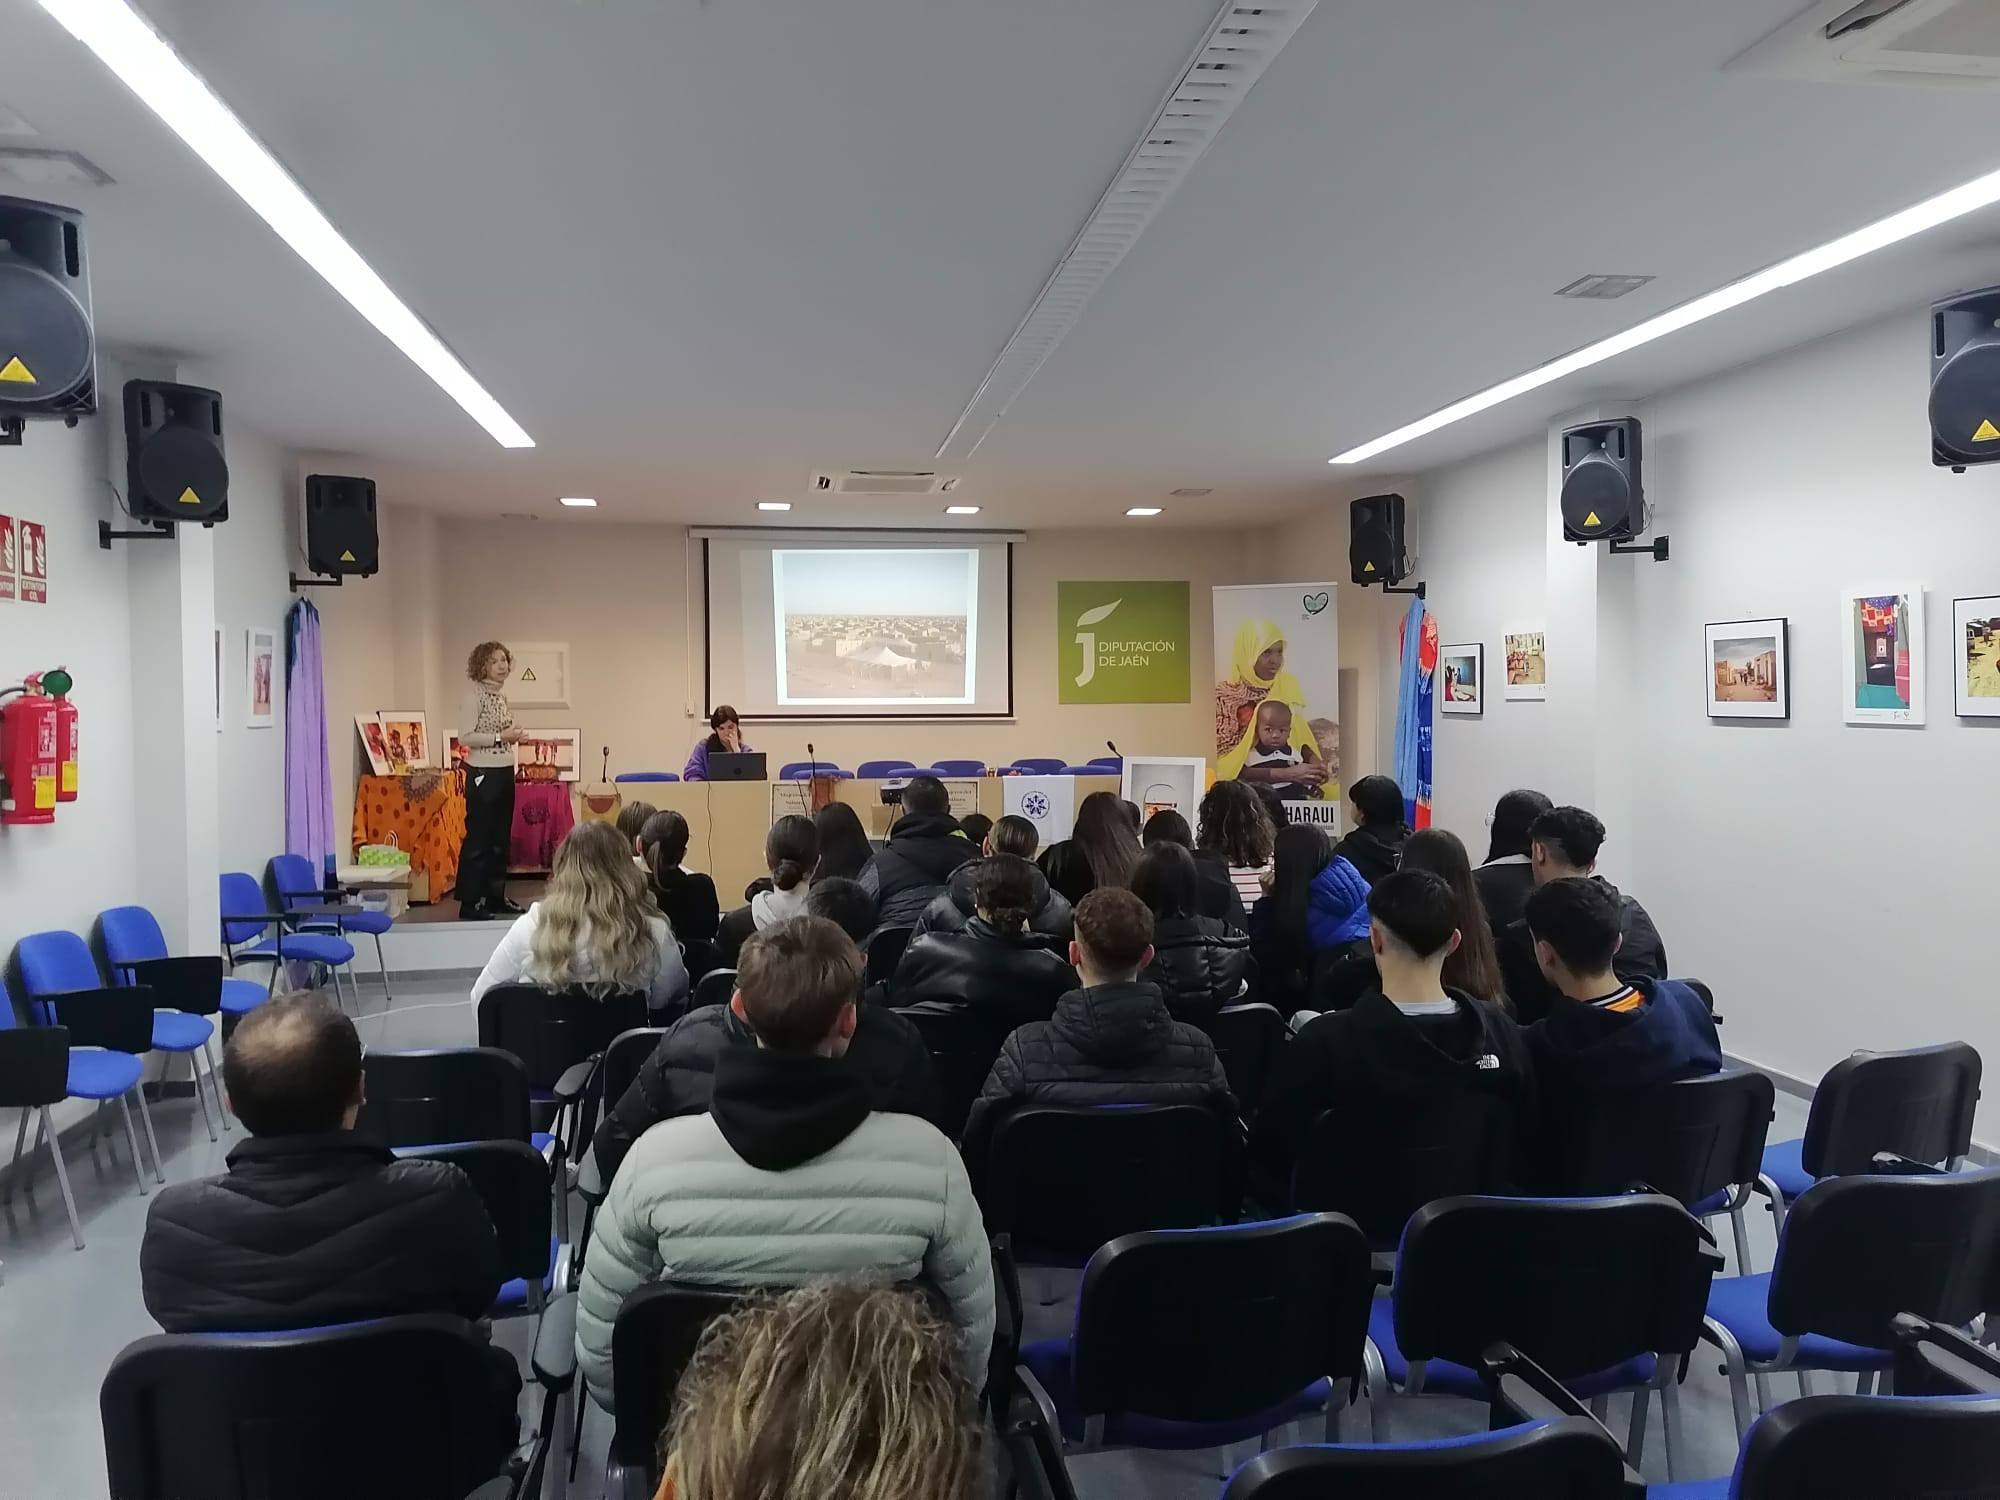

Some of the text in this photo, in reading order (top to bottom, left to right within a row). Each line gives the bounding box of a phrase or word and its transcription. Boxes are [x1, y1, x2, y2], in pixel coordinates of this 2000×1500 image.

[1098, 640, 1175, 652] DIPUTACIÓN
[1098, 654, 1149, 667] DE JAÉN
